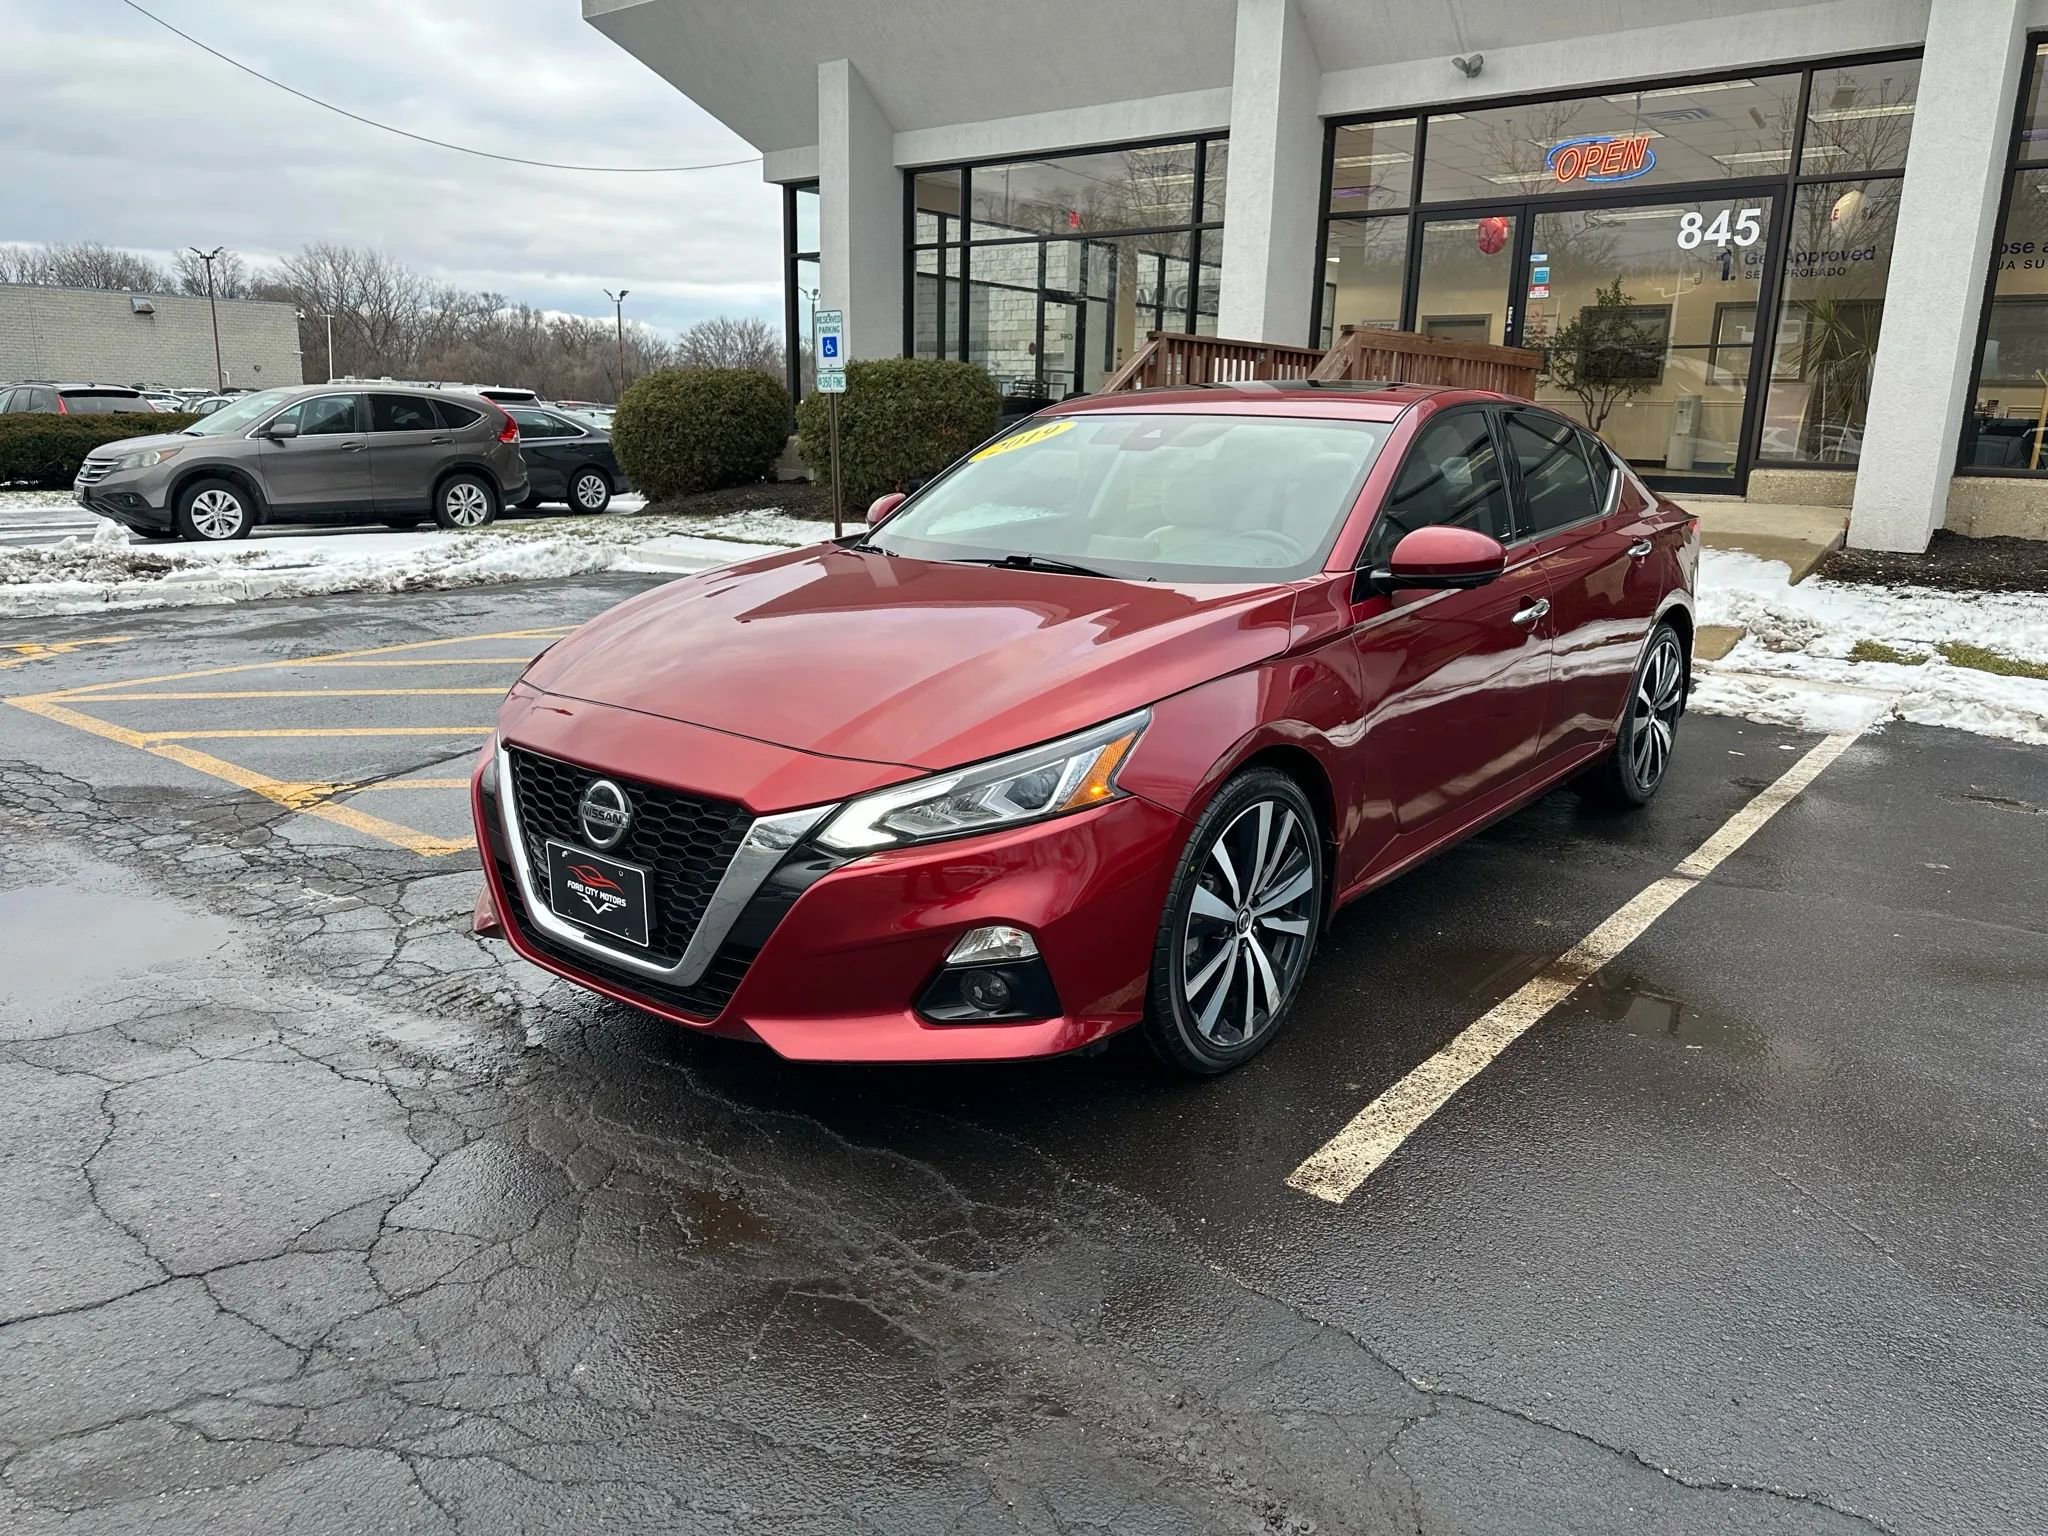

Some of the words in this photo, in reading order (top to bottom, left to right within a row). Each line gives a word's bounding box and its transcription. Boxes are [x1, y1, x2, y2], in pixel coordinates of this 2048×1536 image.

[1556, 136, 1649, 182] OPEN
[1677, 208, 1761, 249] 845
[2023, 259, 2045, 269] SU
[1784, 267, 1846, 278] PROBADO
[816, 315, 841, 324] RESERVED
[818, 325, 840, 334] PARKING
[833, 376, 844, 388] FINE
[582, 805, 621, 825] NISSAN
[567, 880, 584, 892] FORD
[584, 886, 599, 897] CITY
[599, 891, 627, 907] MOTORS
